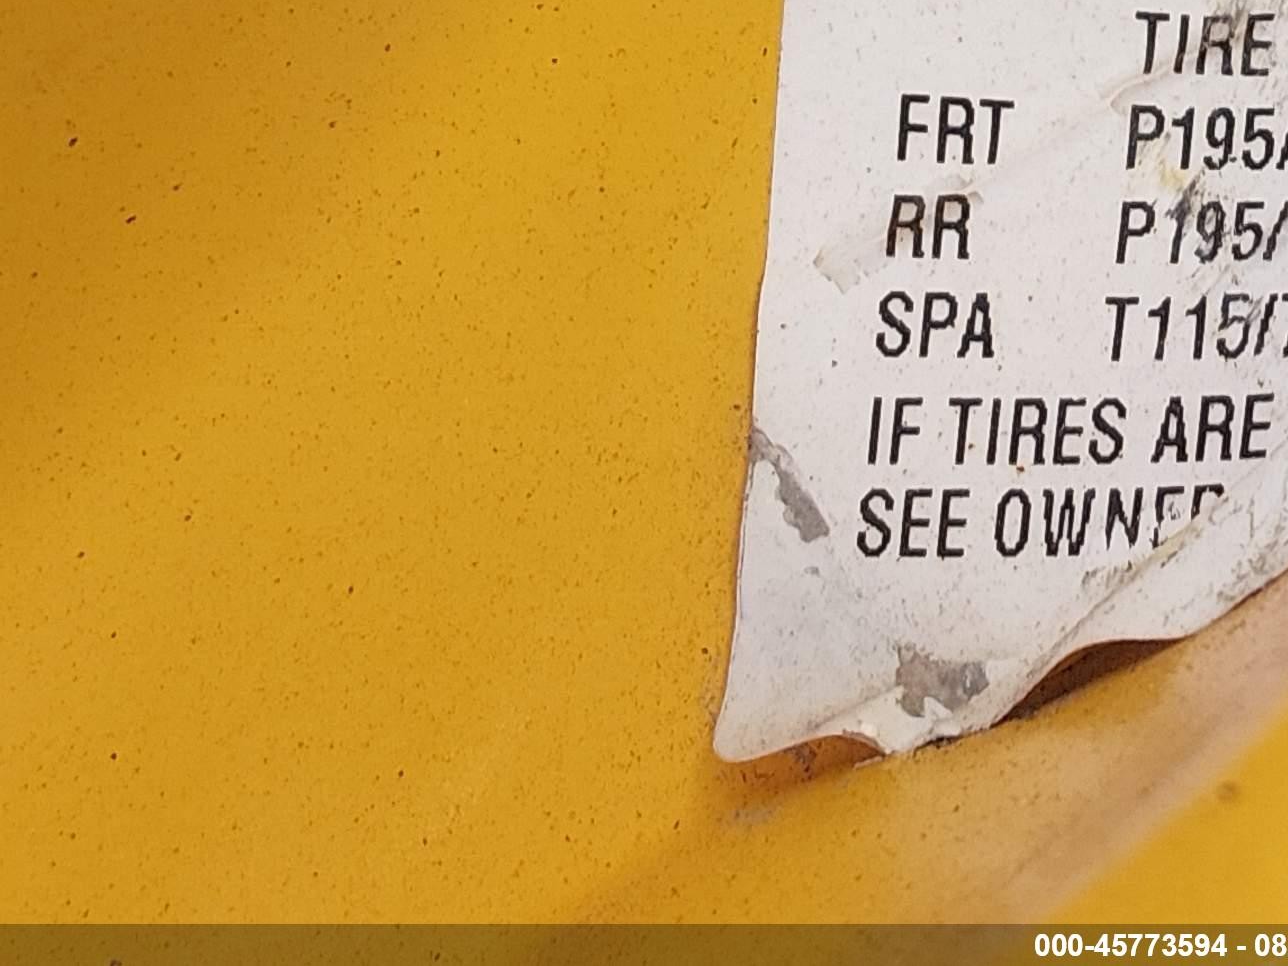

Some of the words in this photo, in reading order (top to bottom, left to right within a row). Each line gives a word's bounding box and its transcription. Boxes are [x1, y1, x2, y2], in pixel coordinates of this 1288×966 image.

[1135, 11, 1275, 77] TIRE
[897, 94, 1015, 165] FRT
[886, 194, 971, 260] RR
[876, 291, 994, 357] SPA
[868, 397, 923, 465] IF
[949, 398, 1127, 465] TIRES
[1150, 393, 1274, 462] ARE
[857, 488, 970, 558] SEE
